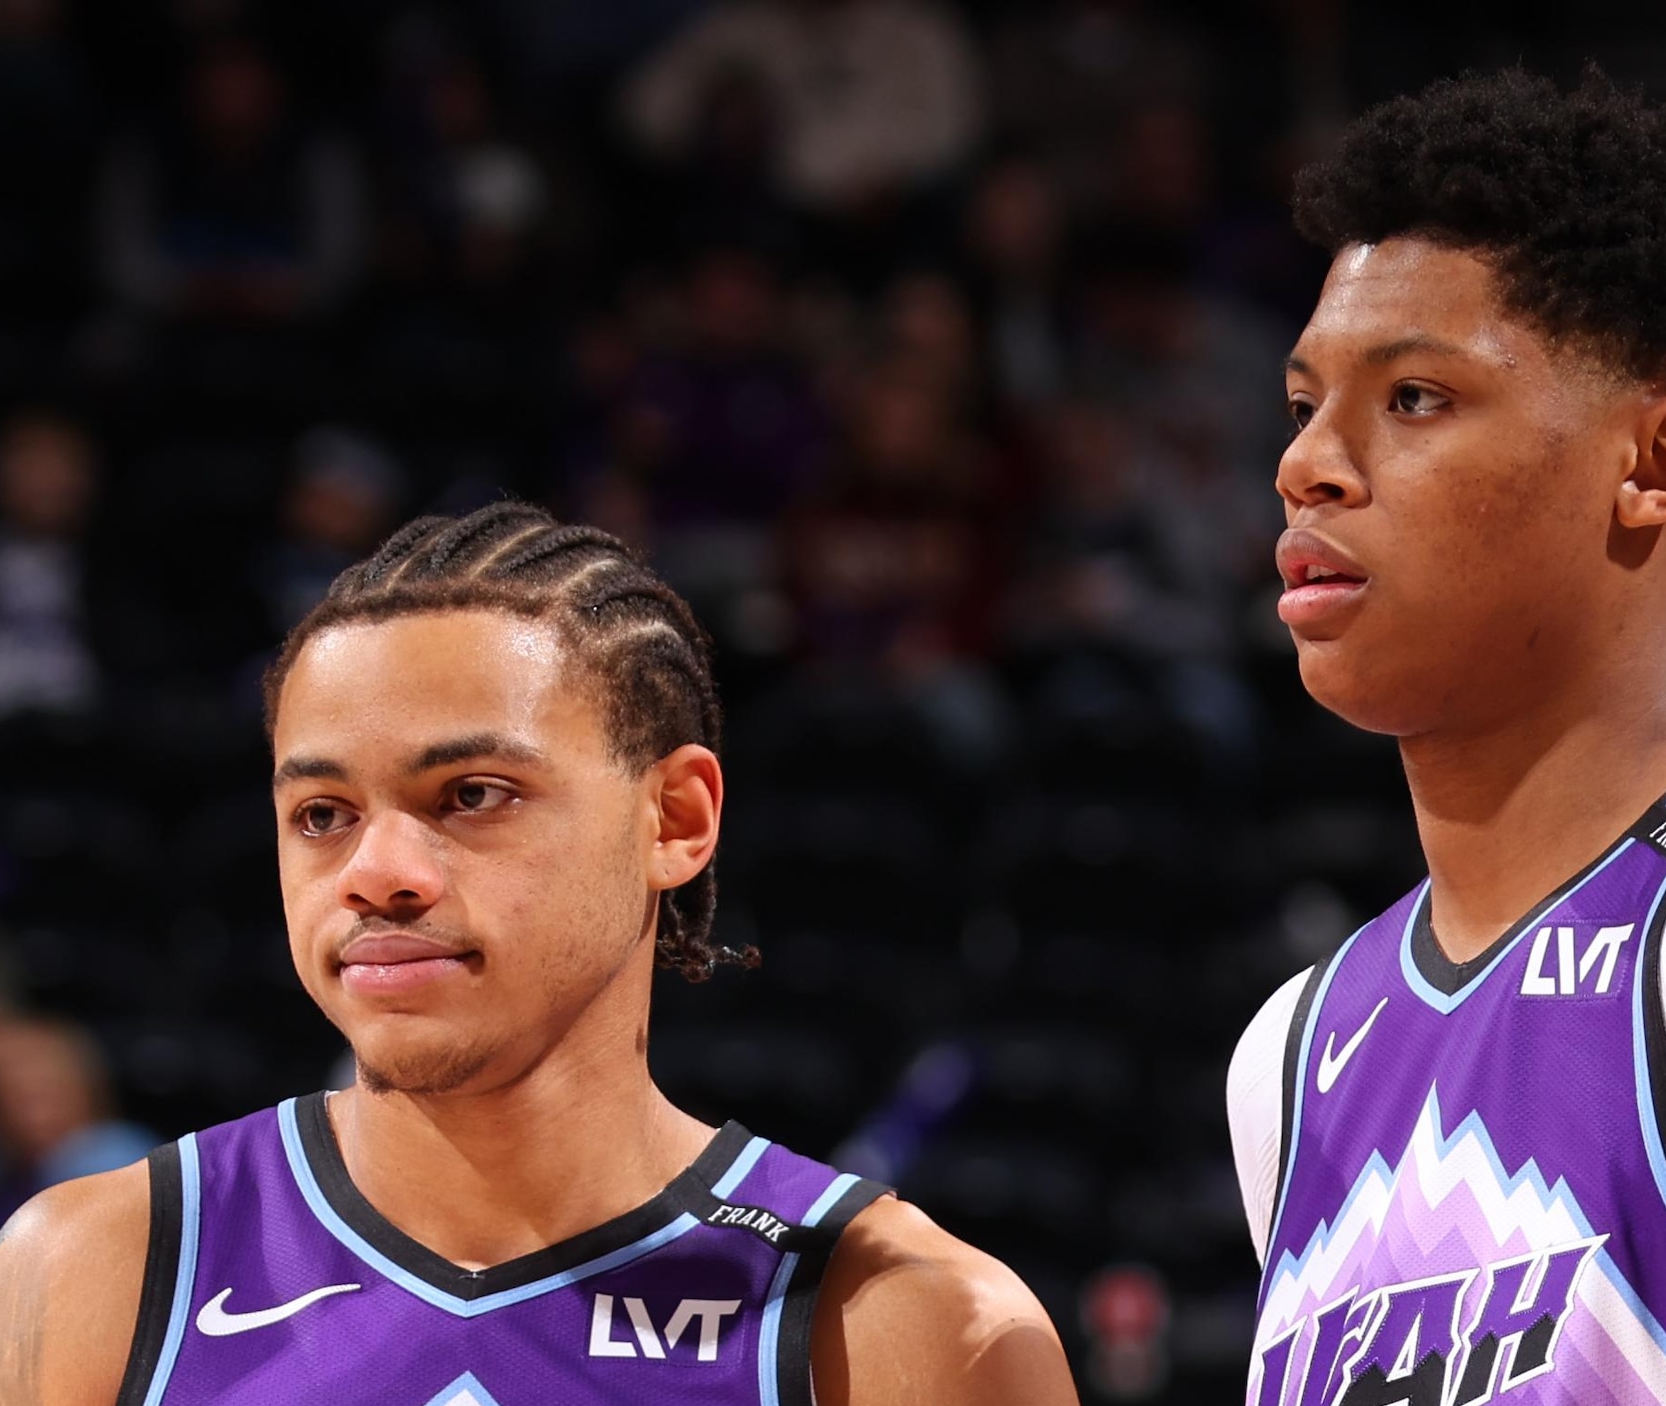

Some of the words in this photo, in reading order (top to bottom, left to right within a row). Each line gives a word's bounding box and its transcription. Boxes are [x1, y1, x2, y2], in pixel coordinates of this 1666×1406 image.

[1520, 923, 1635, 995] LVT
[708, 1205, 790, 1242] FRANK
[589, 1293, 743, 1361] LVT
